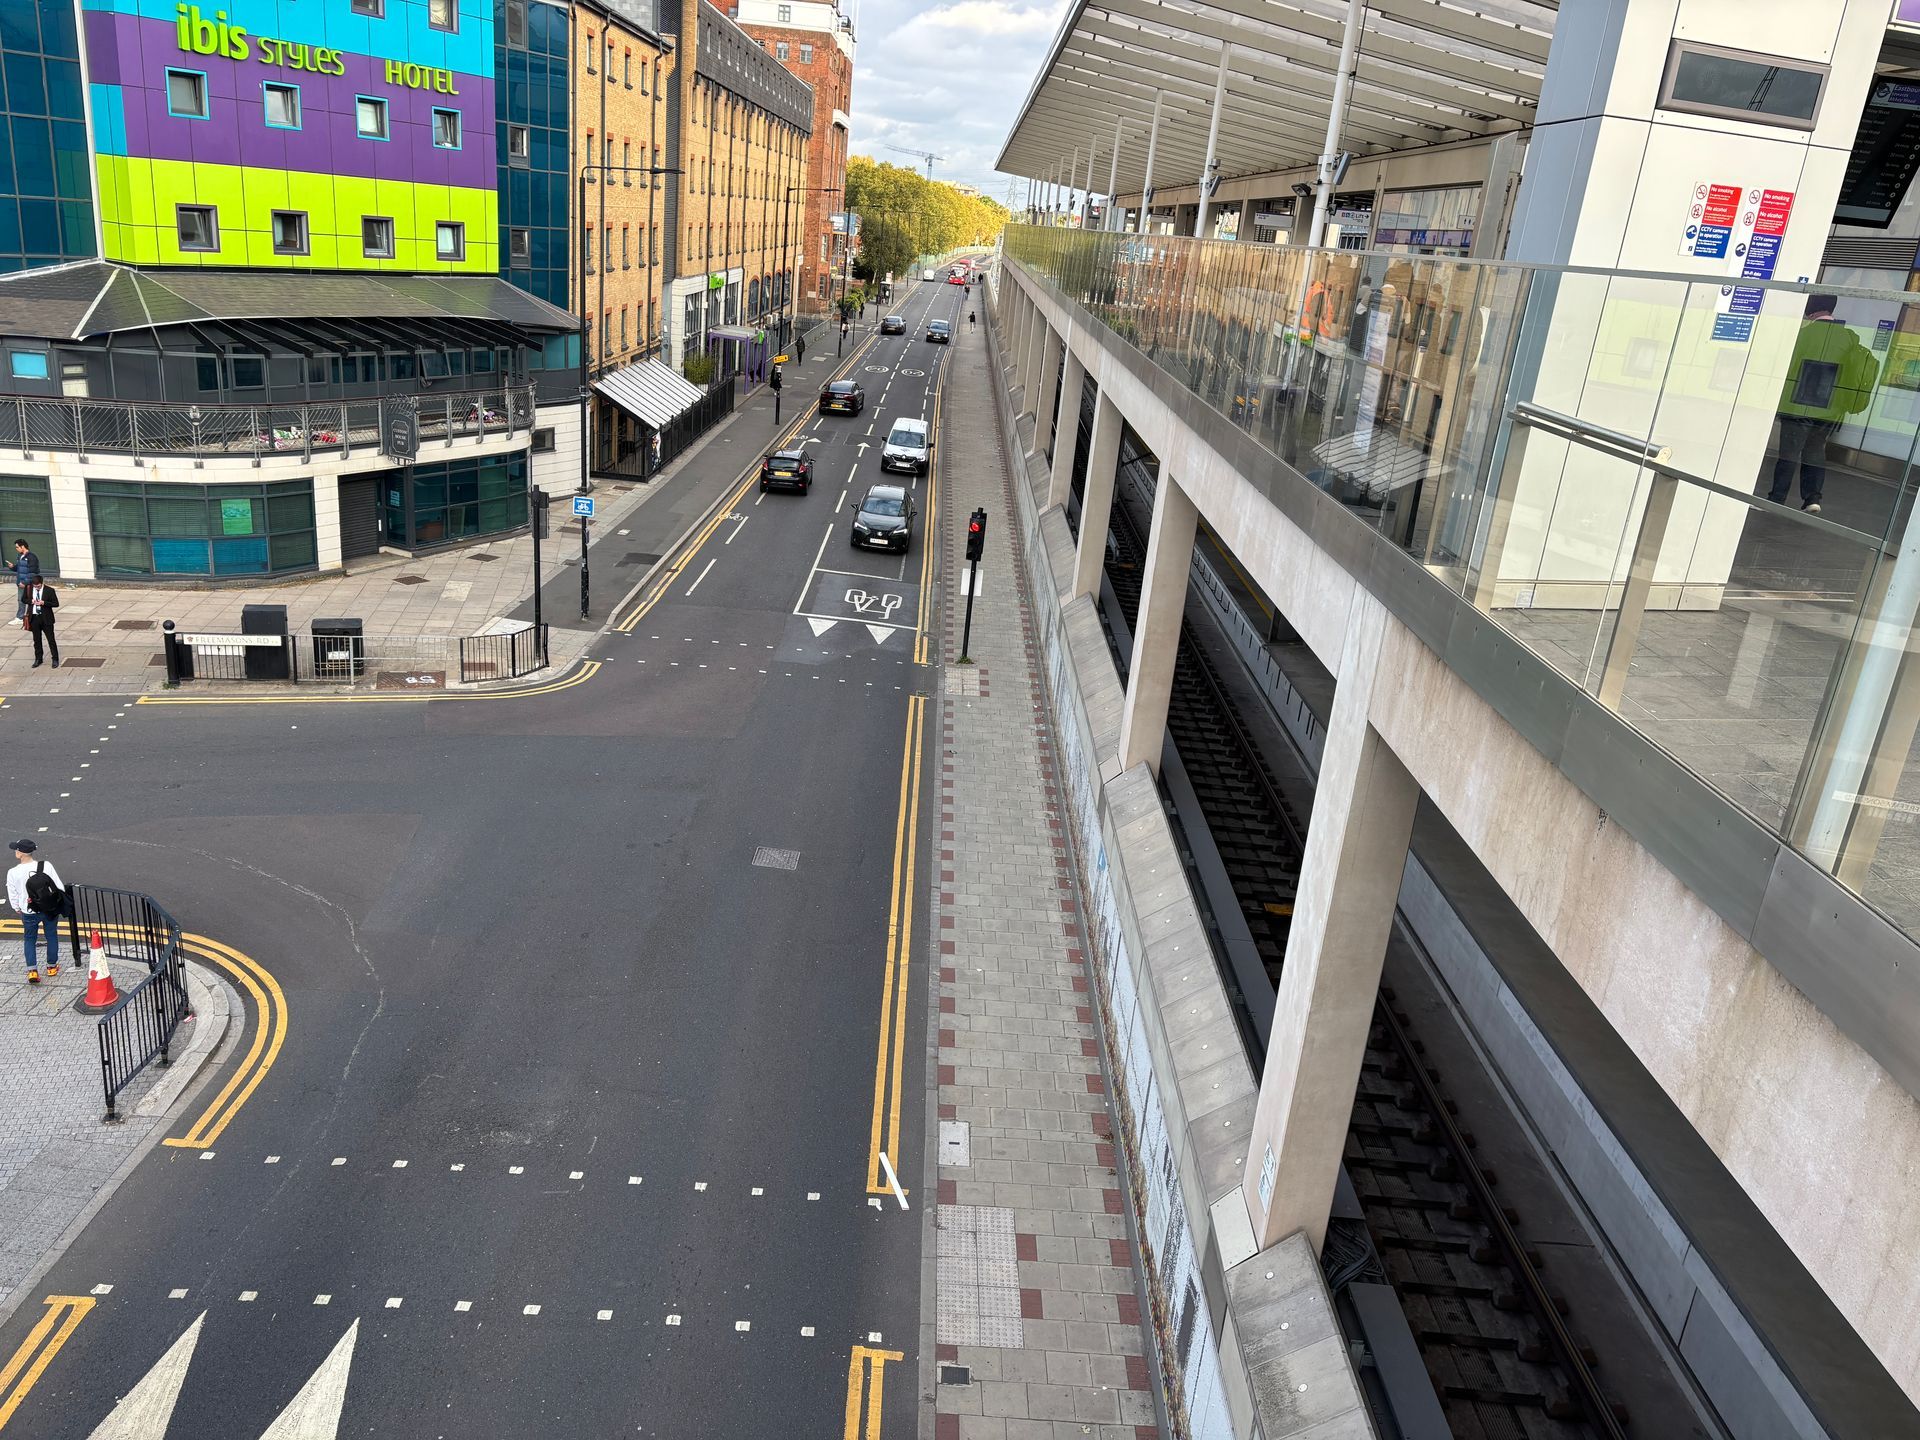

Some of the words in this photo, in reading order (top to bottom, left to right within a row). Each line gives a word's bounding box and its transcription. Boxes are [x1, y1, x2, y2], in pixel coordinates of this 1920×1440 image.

[176, 2, 249, 60] ibis
[385, 59, 460, 96] HOTEL
[195, 635, 253, 644] FREEMASONS
